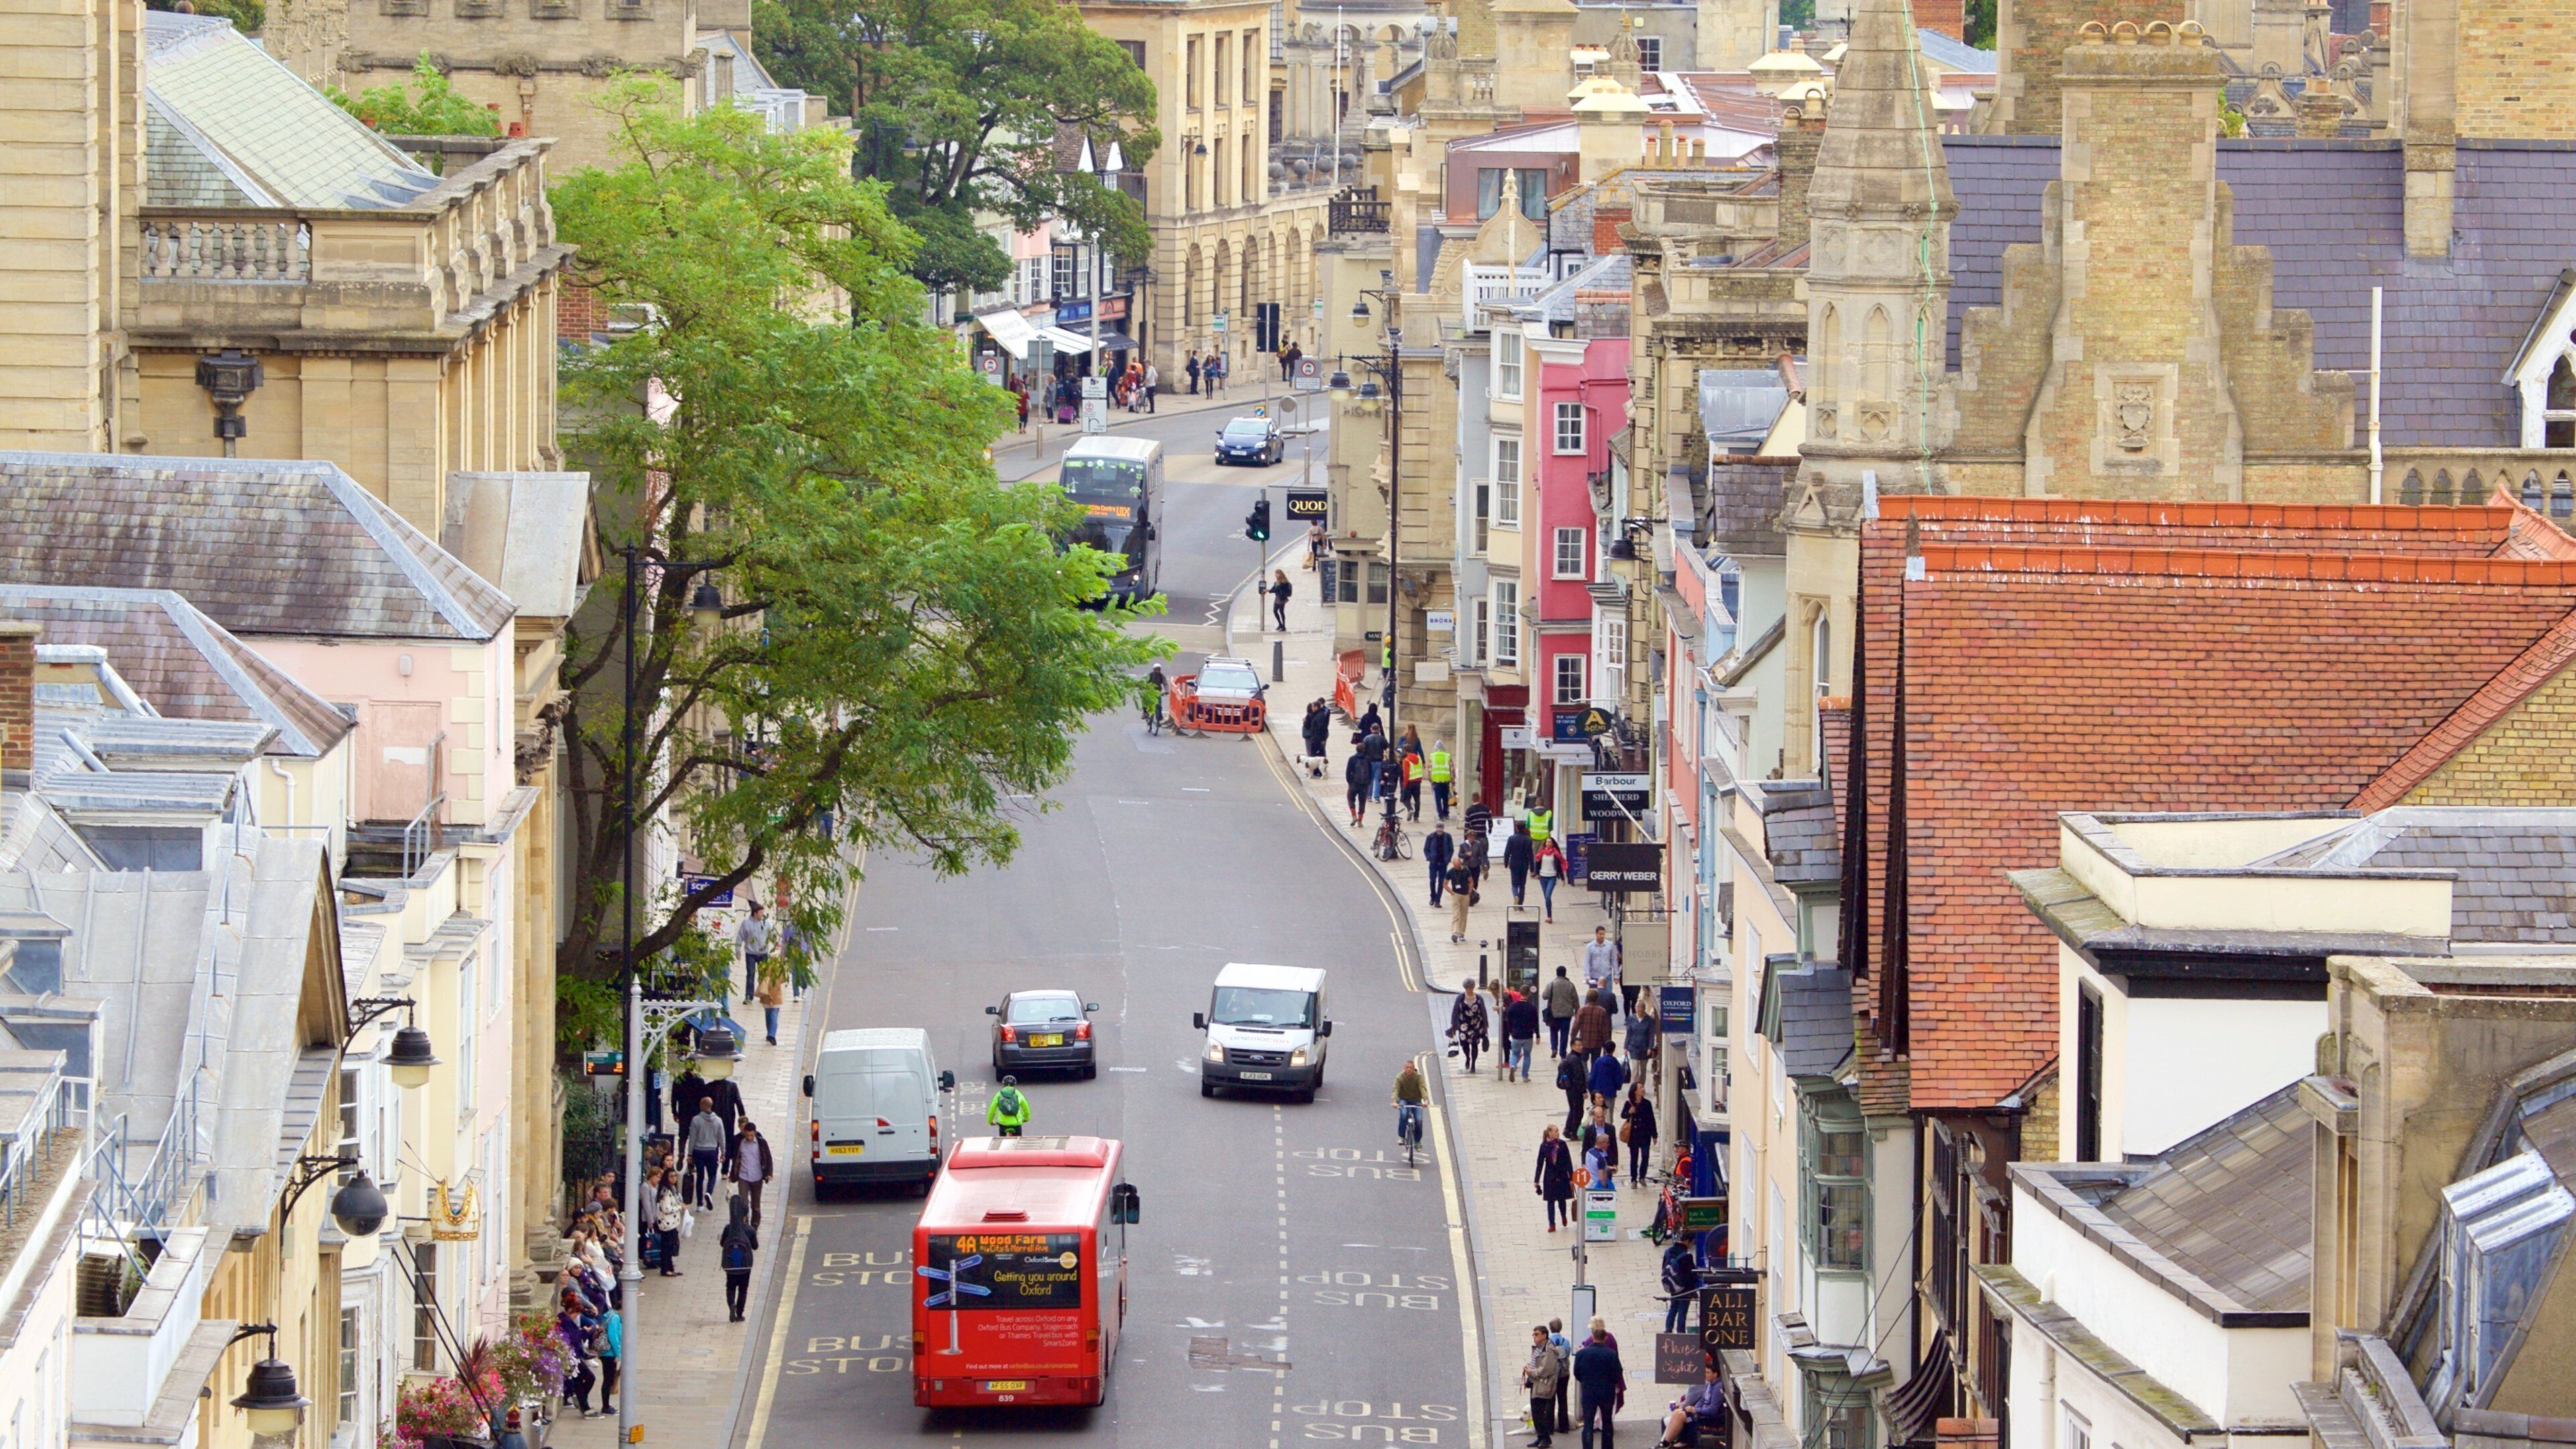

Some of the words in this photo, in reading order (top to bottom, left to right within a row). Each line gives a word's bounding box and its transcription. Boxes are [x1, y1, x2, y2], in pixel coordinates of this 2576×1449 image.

[1289, 500, 1327, 513] QUOD
[1596, 777, 1636, 785] Barbour
[1590, 871, 1622, 880] GERRY
[1623, 871, 1657, 881] WEBER
[1629, 950, 1663, 958] HOBBS
[1292, 1148, 1431, 1164] STOP
[1308, 1165, 1421, 1181] BUS
[957, 1236, 976, 1253] 4A
[980, 1234, 1011, 1244] Wood
[1016, 1235, 1046, 1244] Farm
[823, 1252, 913, 1267] BU
[812, 1271, 912, 1286] STO
[994, 1271, 1026, 1285] Getting
[1028, 1274, 1045, 1285] you
[1046, 1271, 1077, 1281] around
[1297, 1271, 1450, 1290] STOP
[1020, 1284, 1052, 1295] Oxford
[1313, 1291, 1438, 1310] BUS
[1709, 1293, 1748, 1308] ALL
[1707, 1312, 1748, 1326] BAR
[1042, 1324, 1078, 1332] Stagecoach
[1705, 1330, 1749, 1345] ONE
[786, 1357, 913, 1375] STO
[1292, 1400, 1458, 1421] STOP
[1305, 1423, 1438, 1444] BUS
